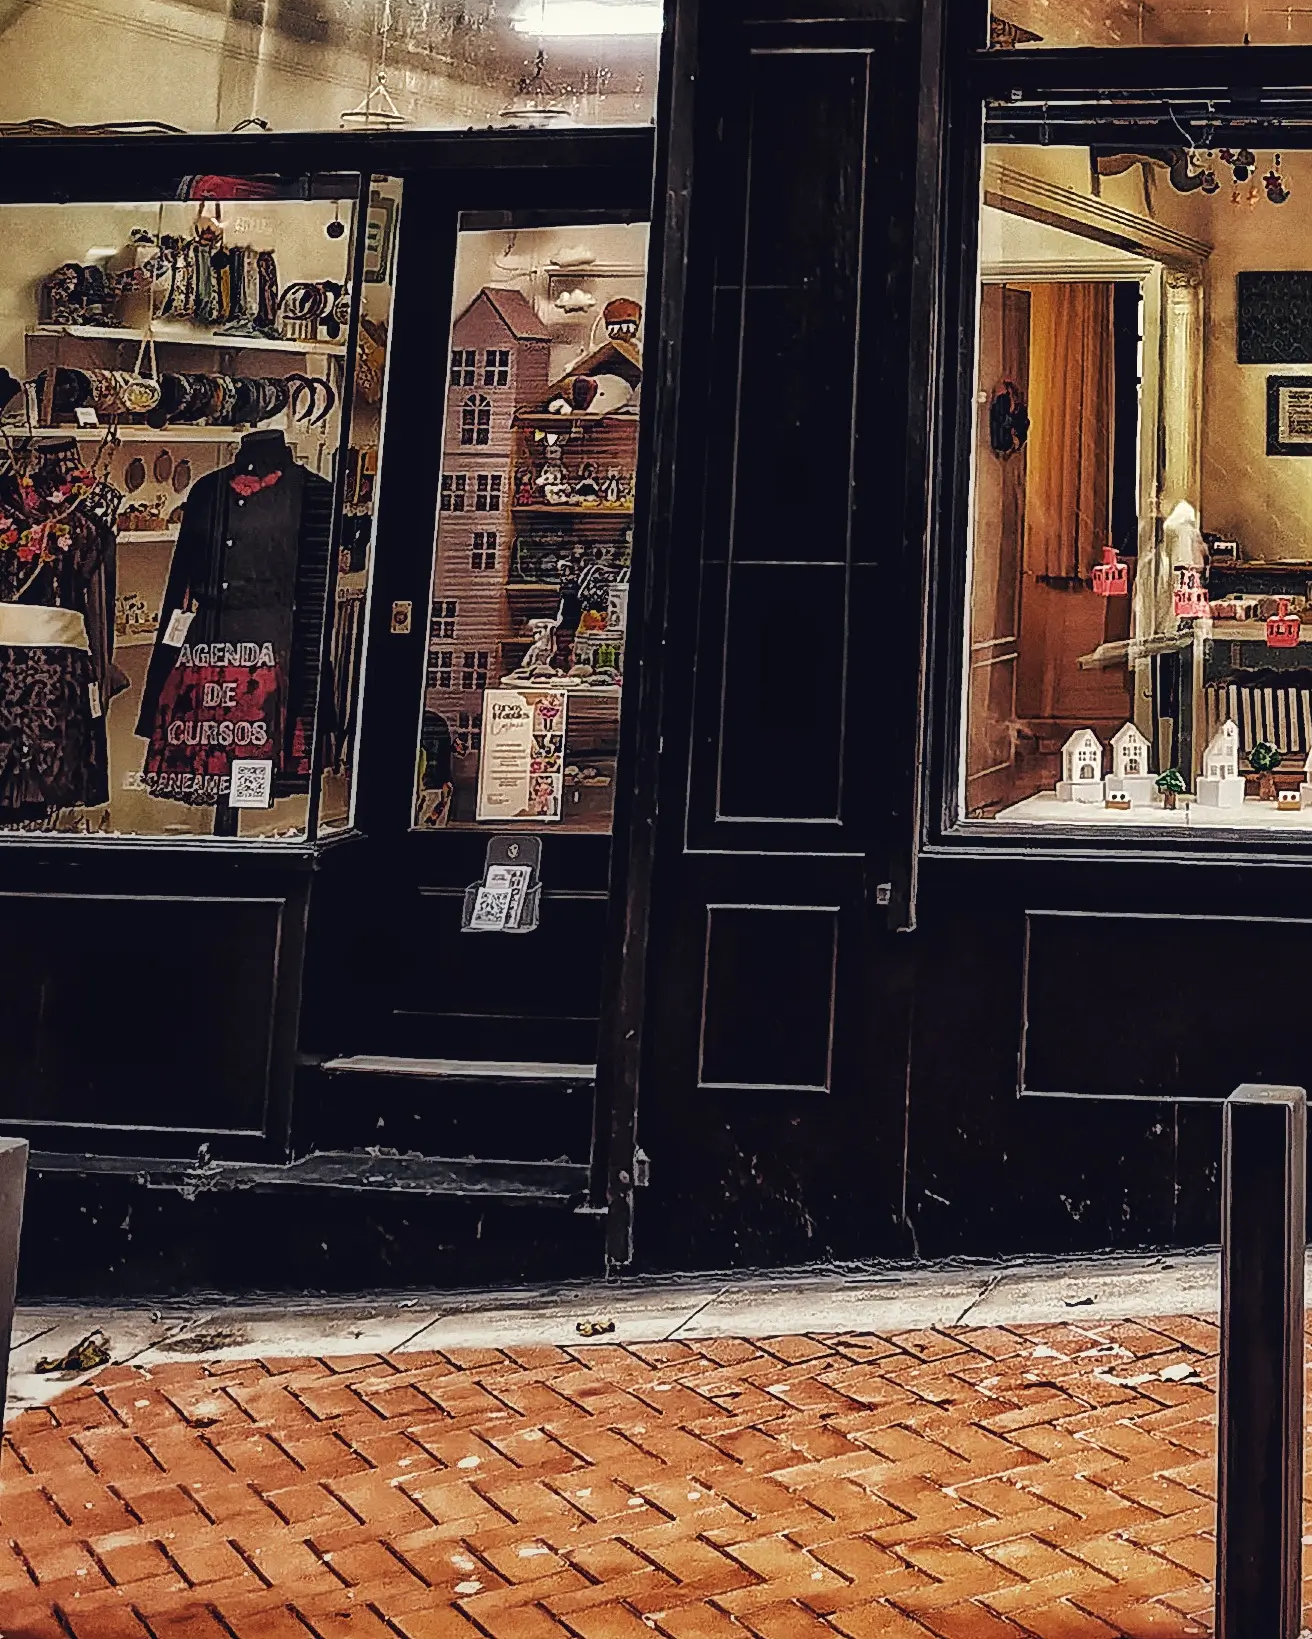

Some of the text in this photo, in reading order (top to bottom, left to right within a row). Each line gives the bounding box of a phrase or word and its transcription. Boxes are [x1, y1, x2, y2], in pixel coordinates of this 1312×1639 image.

[175, 642, 276, 668] AGENDA
[203, 682, 237, 708] DE
[166, 720, 268, 747] CURSOS
